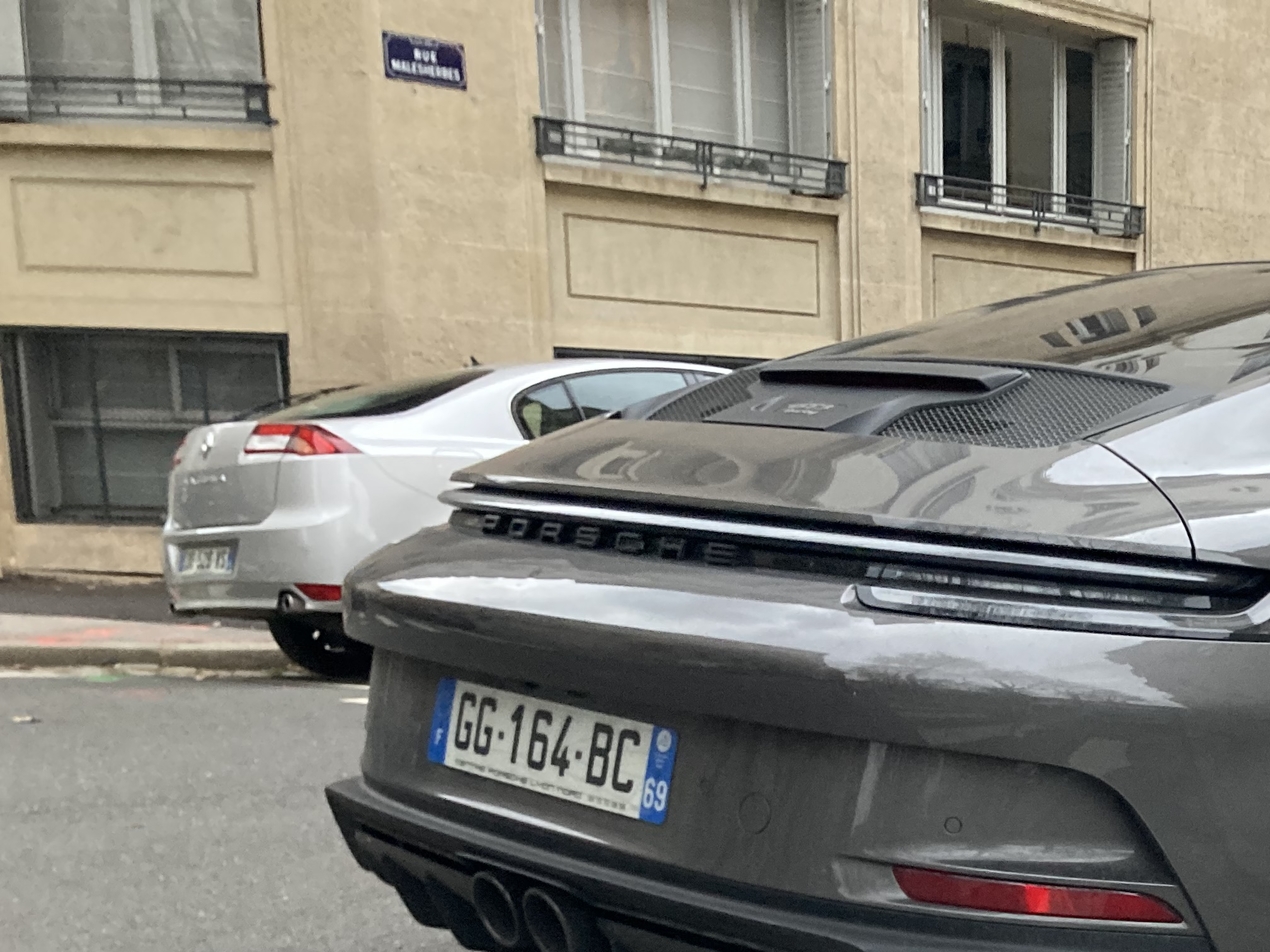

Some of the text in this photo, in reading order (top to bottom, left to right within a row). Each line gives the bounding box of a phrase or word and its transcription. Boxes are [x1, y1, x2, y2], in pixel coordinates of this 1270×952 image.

[413, 47, 438, 64] RUE
[481, 513, 740, 566] PORSCHE
[641, 777, 668, 812] 69
